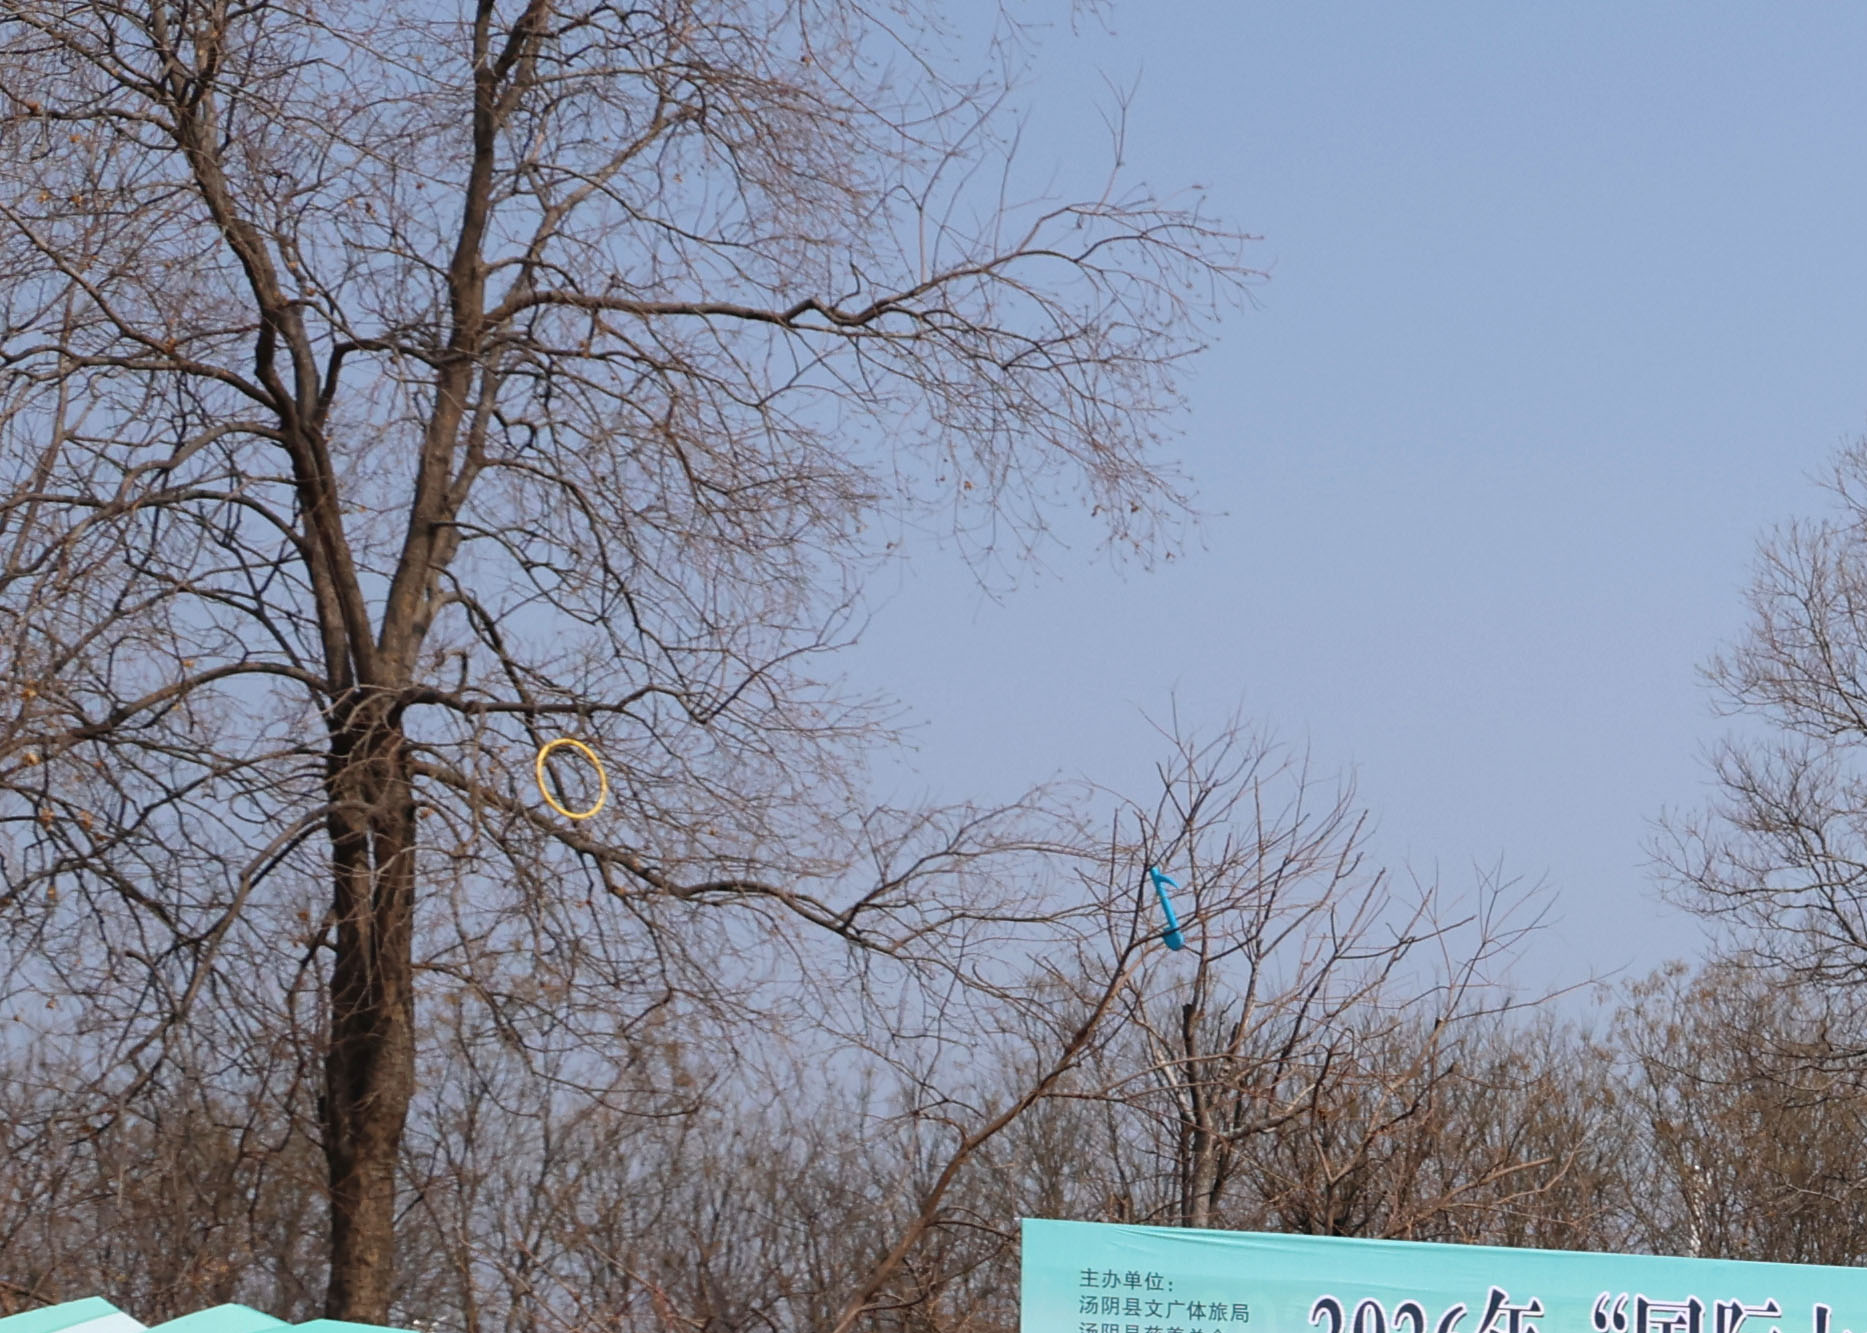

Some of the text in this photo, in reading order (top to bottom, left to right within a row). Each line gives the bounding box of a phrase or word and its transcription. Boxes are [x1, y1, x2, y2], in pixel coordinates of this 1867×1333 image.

[1079, 1267, 1174, 1293] 主办单位：
[1078, 1294, 1250, 1324] 汤阴县文广体旅局
